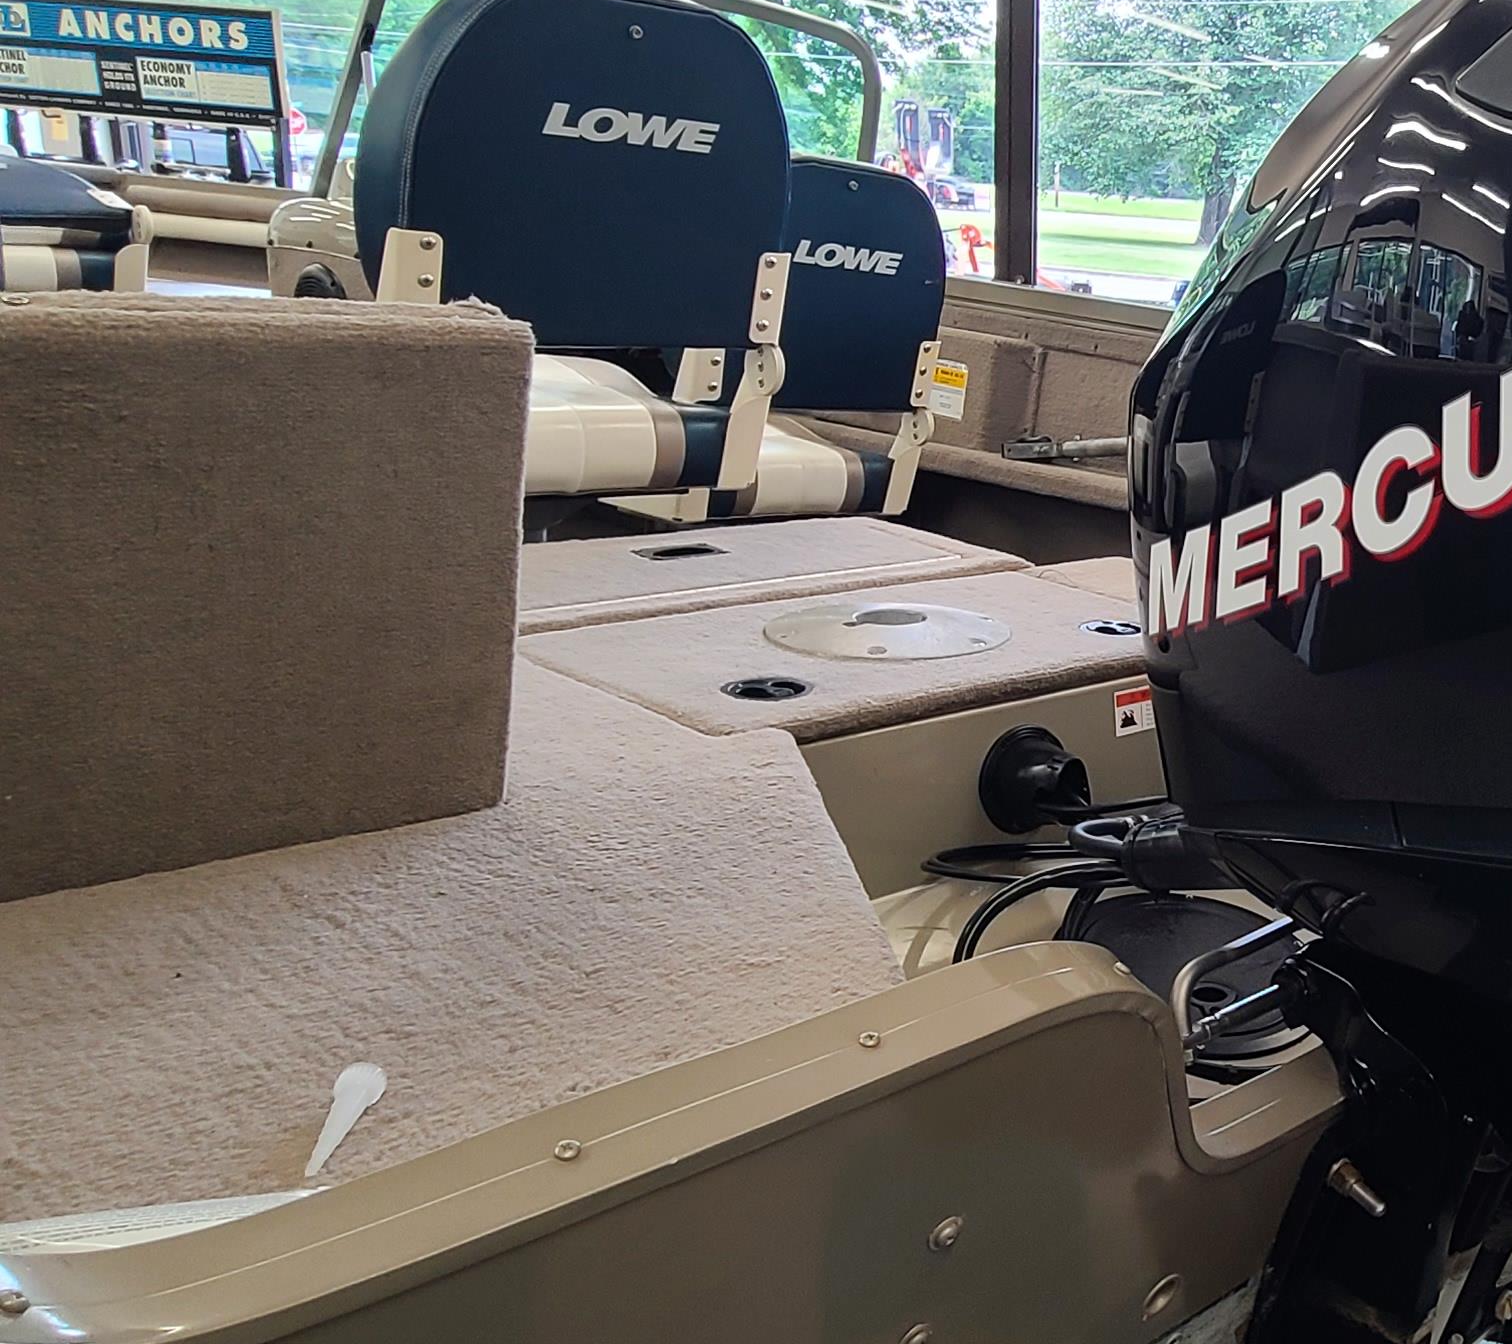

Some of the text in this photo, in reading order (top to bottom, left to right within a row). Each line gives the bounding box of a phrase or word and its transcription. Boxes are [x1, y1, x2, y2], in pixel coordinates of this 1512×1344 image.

[58, 8, 249, 50] ANCHORS
[140, 60, 192, 75] ECONOMY
[143, 74, 186, 88] ANCHOR
[542, 101, 720, 155] LOWE
[793, 239, 903, 276] LOWE
